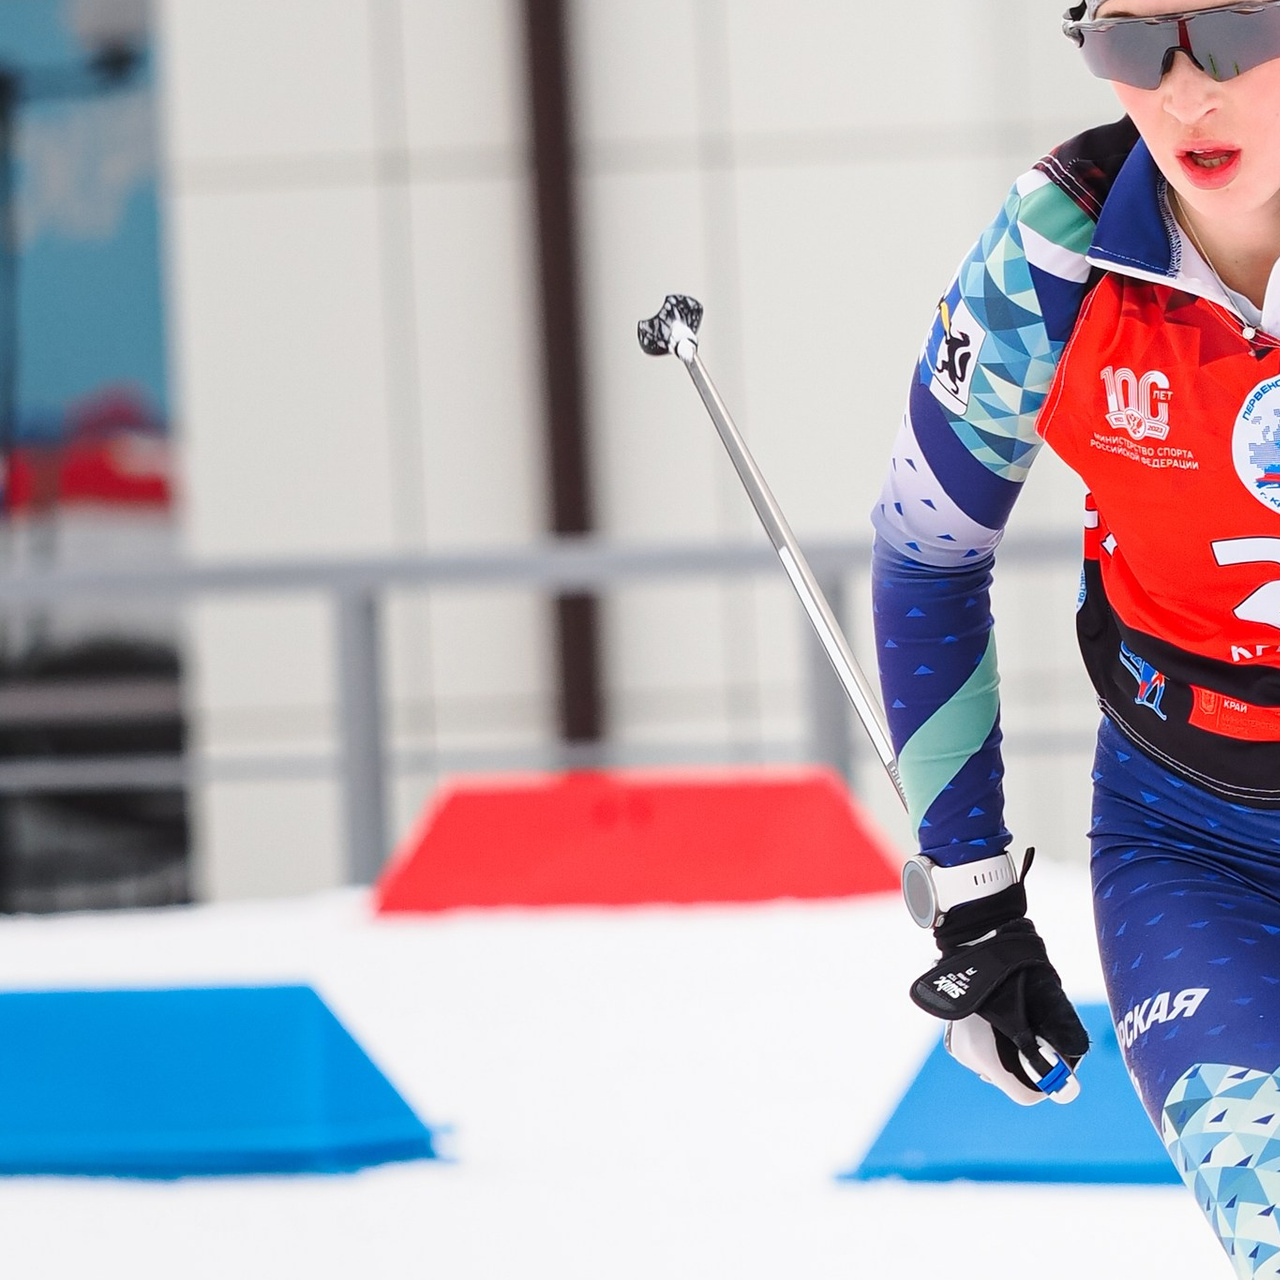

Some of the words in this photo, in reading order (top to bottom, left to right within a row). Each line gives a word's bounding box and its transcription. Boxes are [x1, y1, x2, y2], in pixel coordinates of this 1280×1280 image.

[1152, 390, 1174, 401] ЛЕТ
[1090, 439, 1140, 464] РОССИЙСКОЙ
[1140, 456, 1200, 470] ФЕДЕРАЦИИ
[1093, 432, 1155, 457] МИНИСТЕРСТВО
[1156, 447, 1194, 460] СПОРТА
